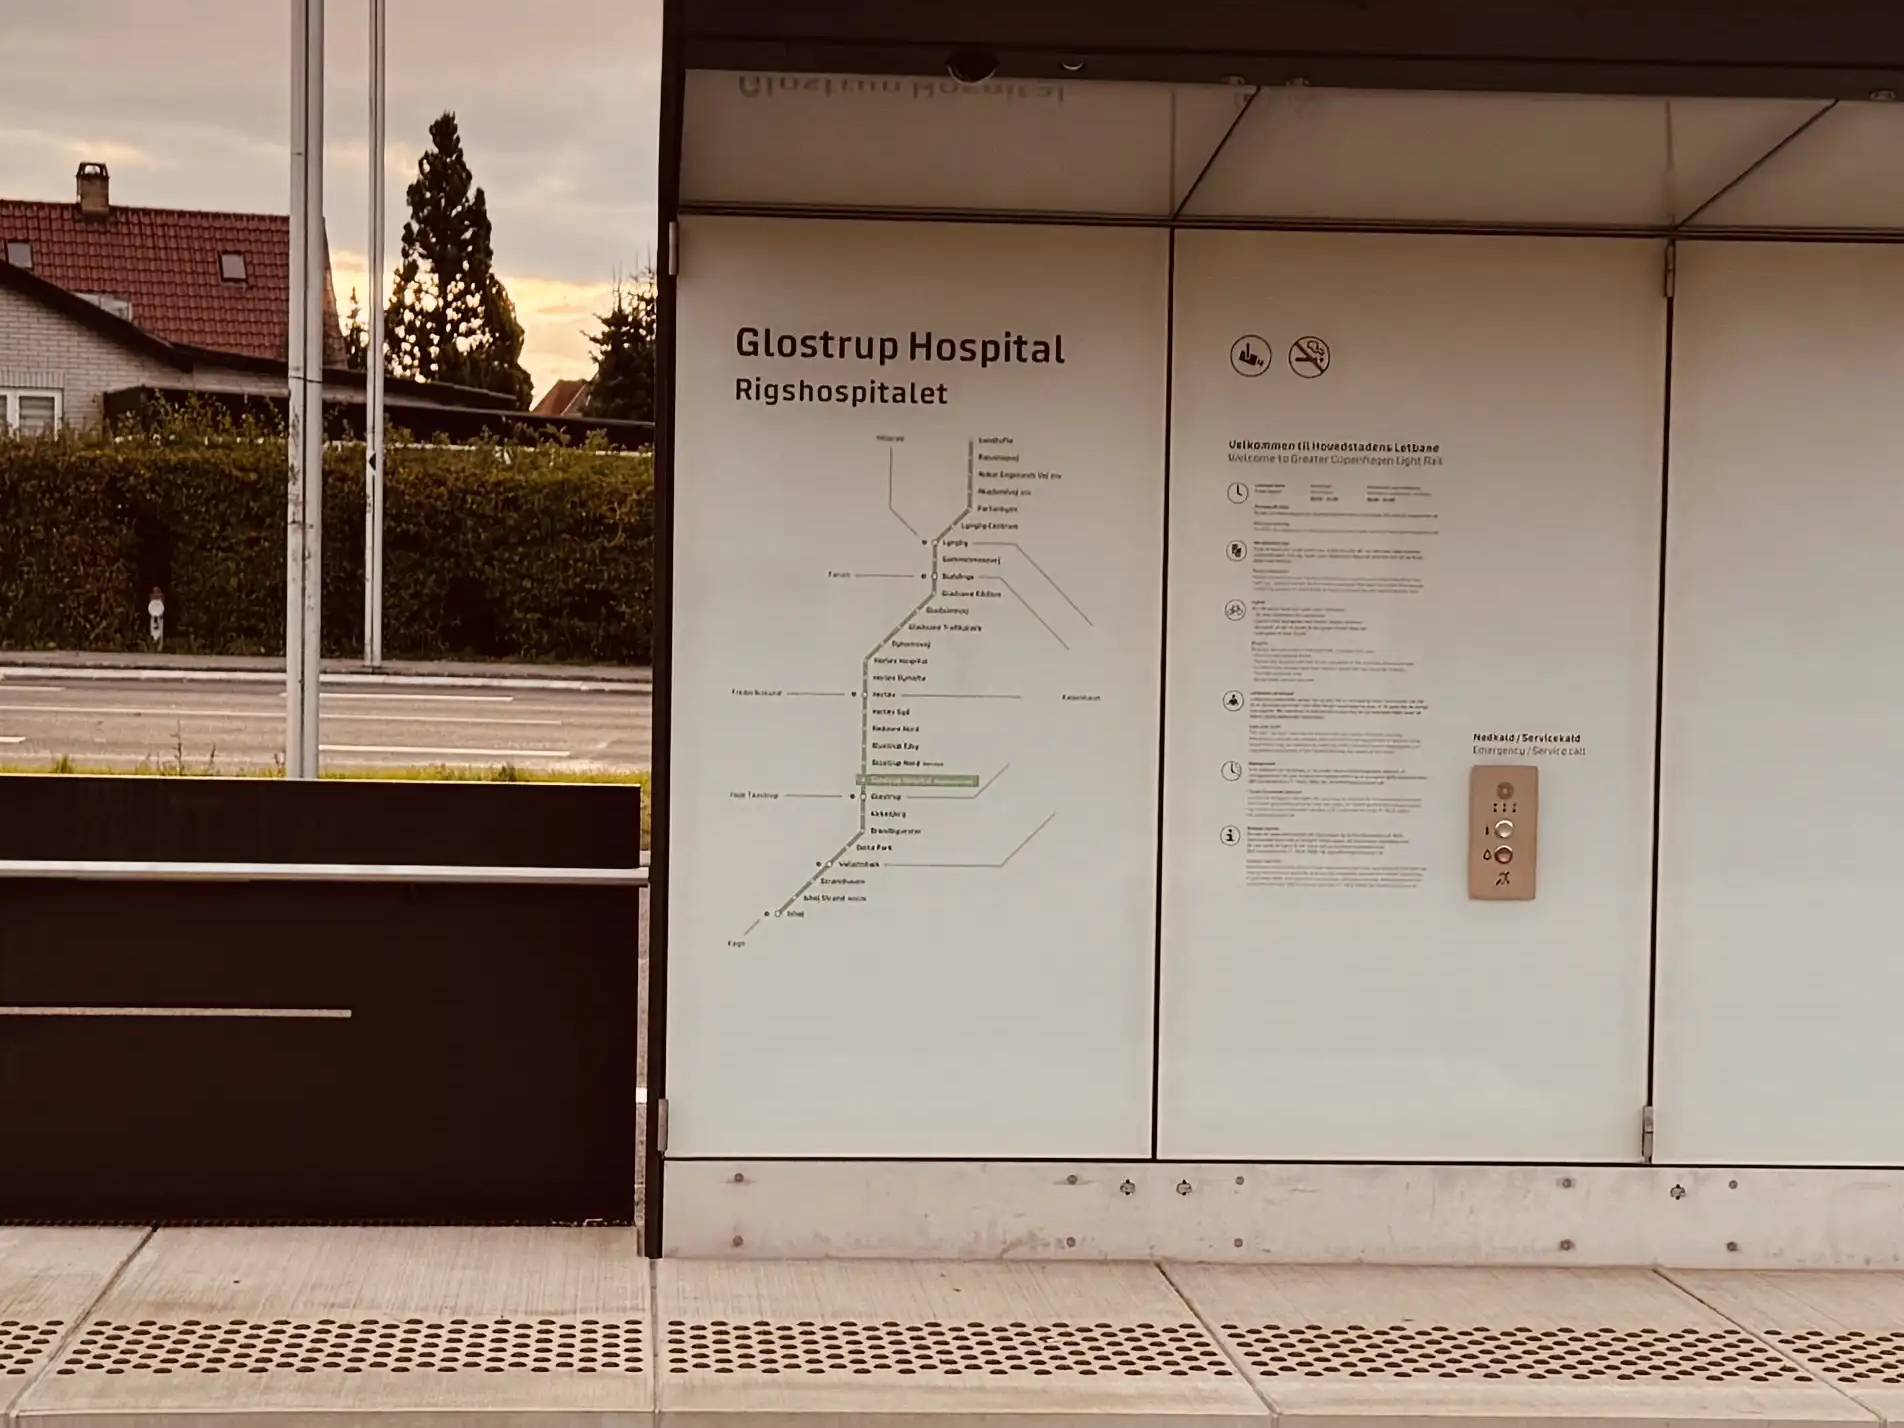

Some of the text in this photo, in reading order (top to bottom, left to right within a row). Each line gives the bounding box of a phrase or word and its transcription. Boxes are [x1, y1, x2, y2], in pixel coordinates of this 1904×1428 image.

[737, 327, 1065, 368] Glostrup Hospital
[736, 377, 947, 407] Rigshospitalet
[1229, 439, 1440, 454] Velkommen til Hovedstadens Letbane
[1474, 733, 1515, 742] Nedkald
[1522, 733, 1581, 743] Servicekald
